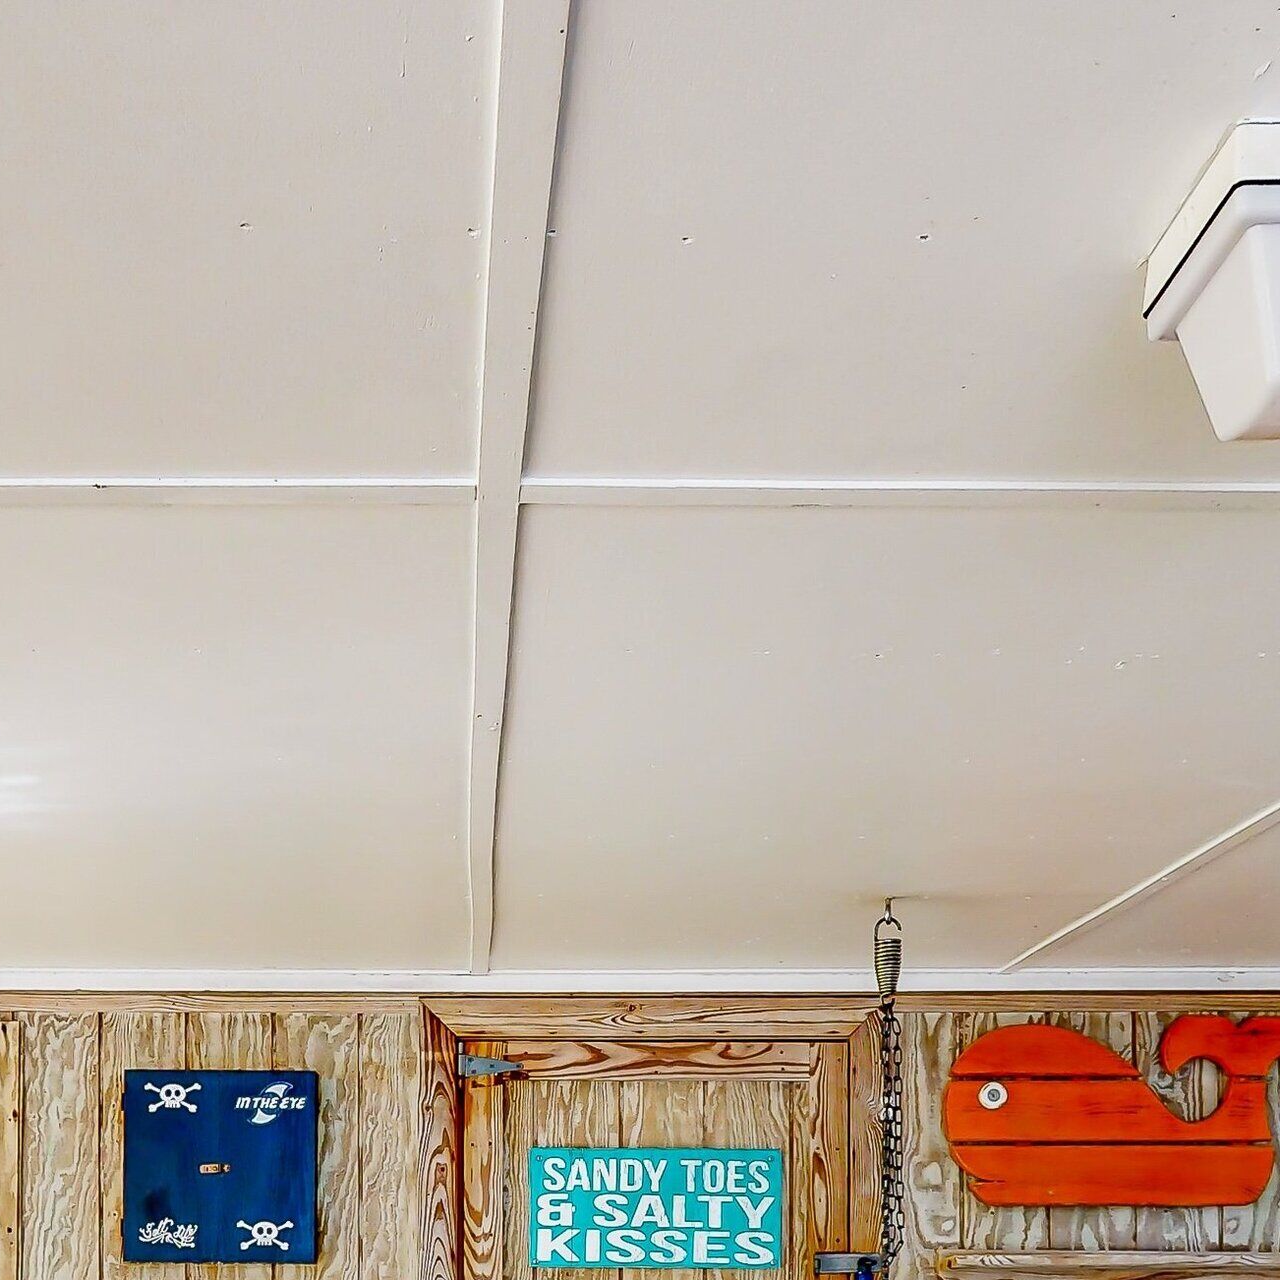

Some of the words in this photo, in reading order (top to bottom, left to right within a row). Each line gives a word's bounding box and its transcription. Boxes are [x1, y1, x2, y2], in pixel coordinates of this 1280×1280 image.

[252, 1096, 280, 1109] THE
[279, 1096, 307, 1109] EYE
[542, 1157, 667, 1192] SANDY
[679, 1159, 771, 1194] TOES
[536, 1193, 576, 1227] &
[592, 1194, 776, 1229] SALTY
[536, 1229, 776, 1265] KISSES
